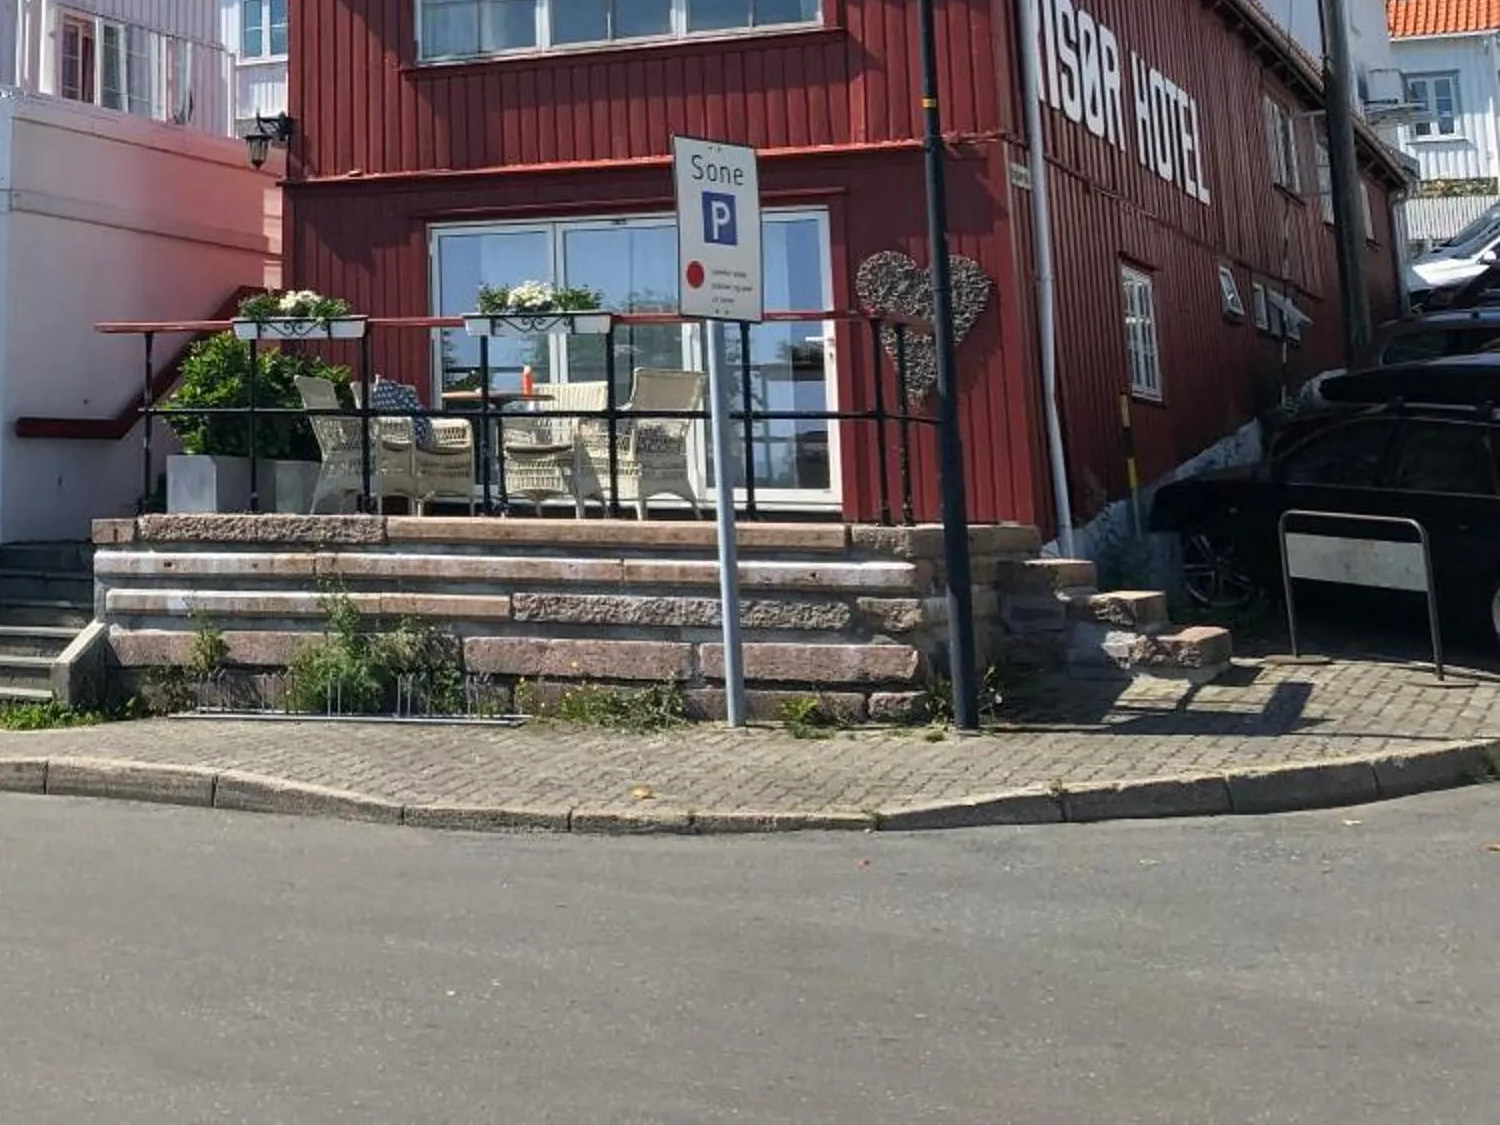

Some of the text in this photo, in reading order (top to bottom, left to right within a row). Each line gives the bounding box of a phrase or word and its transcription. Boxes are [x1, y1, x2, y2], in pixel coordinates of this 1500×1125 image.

[1131, 50, 1211, 206] HOTEL
[691, 154, 745, 186] Sone
[711, 200, 731, 241] P
